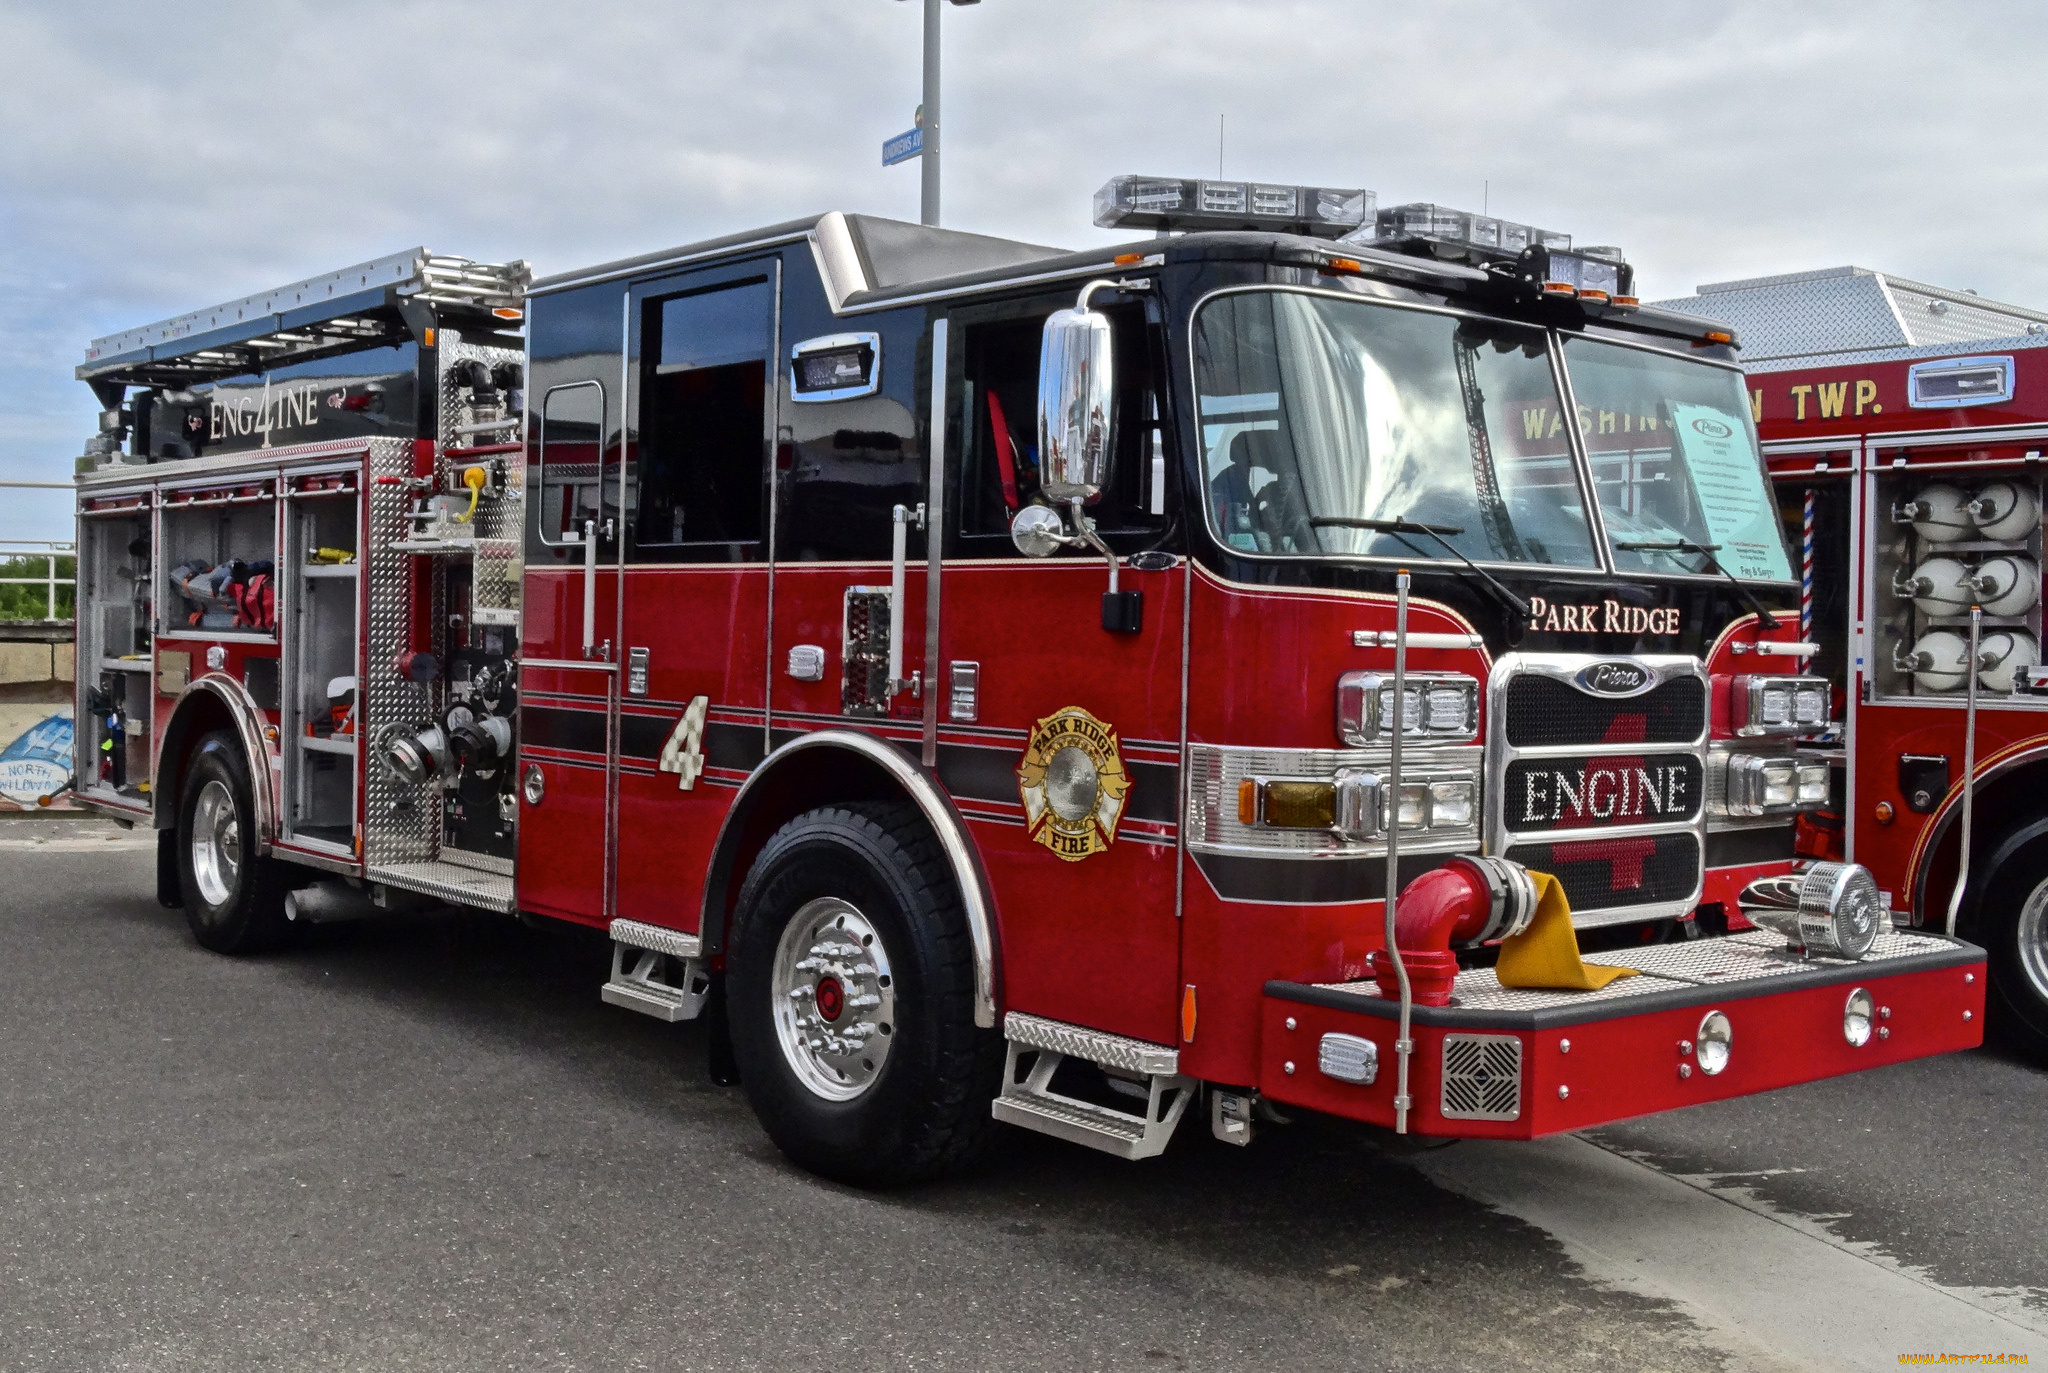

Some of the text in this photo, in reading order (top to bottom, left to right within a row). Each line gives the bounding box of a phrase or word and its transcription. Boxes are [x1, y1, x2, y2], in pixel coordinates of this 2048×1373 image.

[1790, 379, 1883, 421] TWP.
[1529, 596, 1681, 635] PARK RIDGE
[1594, 664, 1641, 692] Pierce
[659, 695, 709, 791] 4
[1033, 718, 1070, 754] PARK
[1073, 718, 1116, 762] RIDGE
[1522, 765, 1687, 822] ENGINE
[1050, 832, 1091, 853] FIRE
